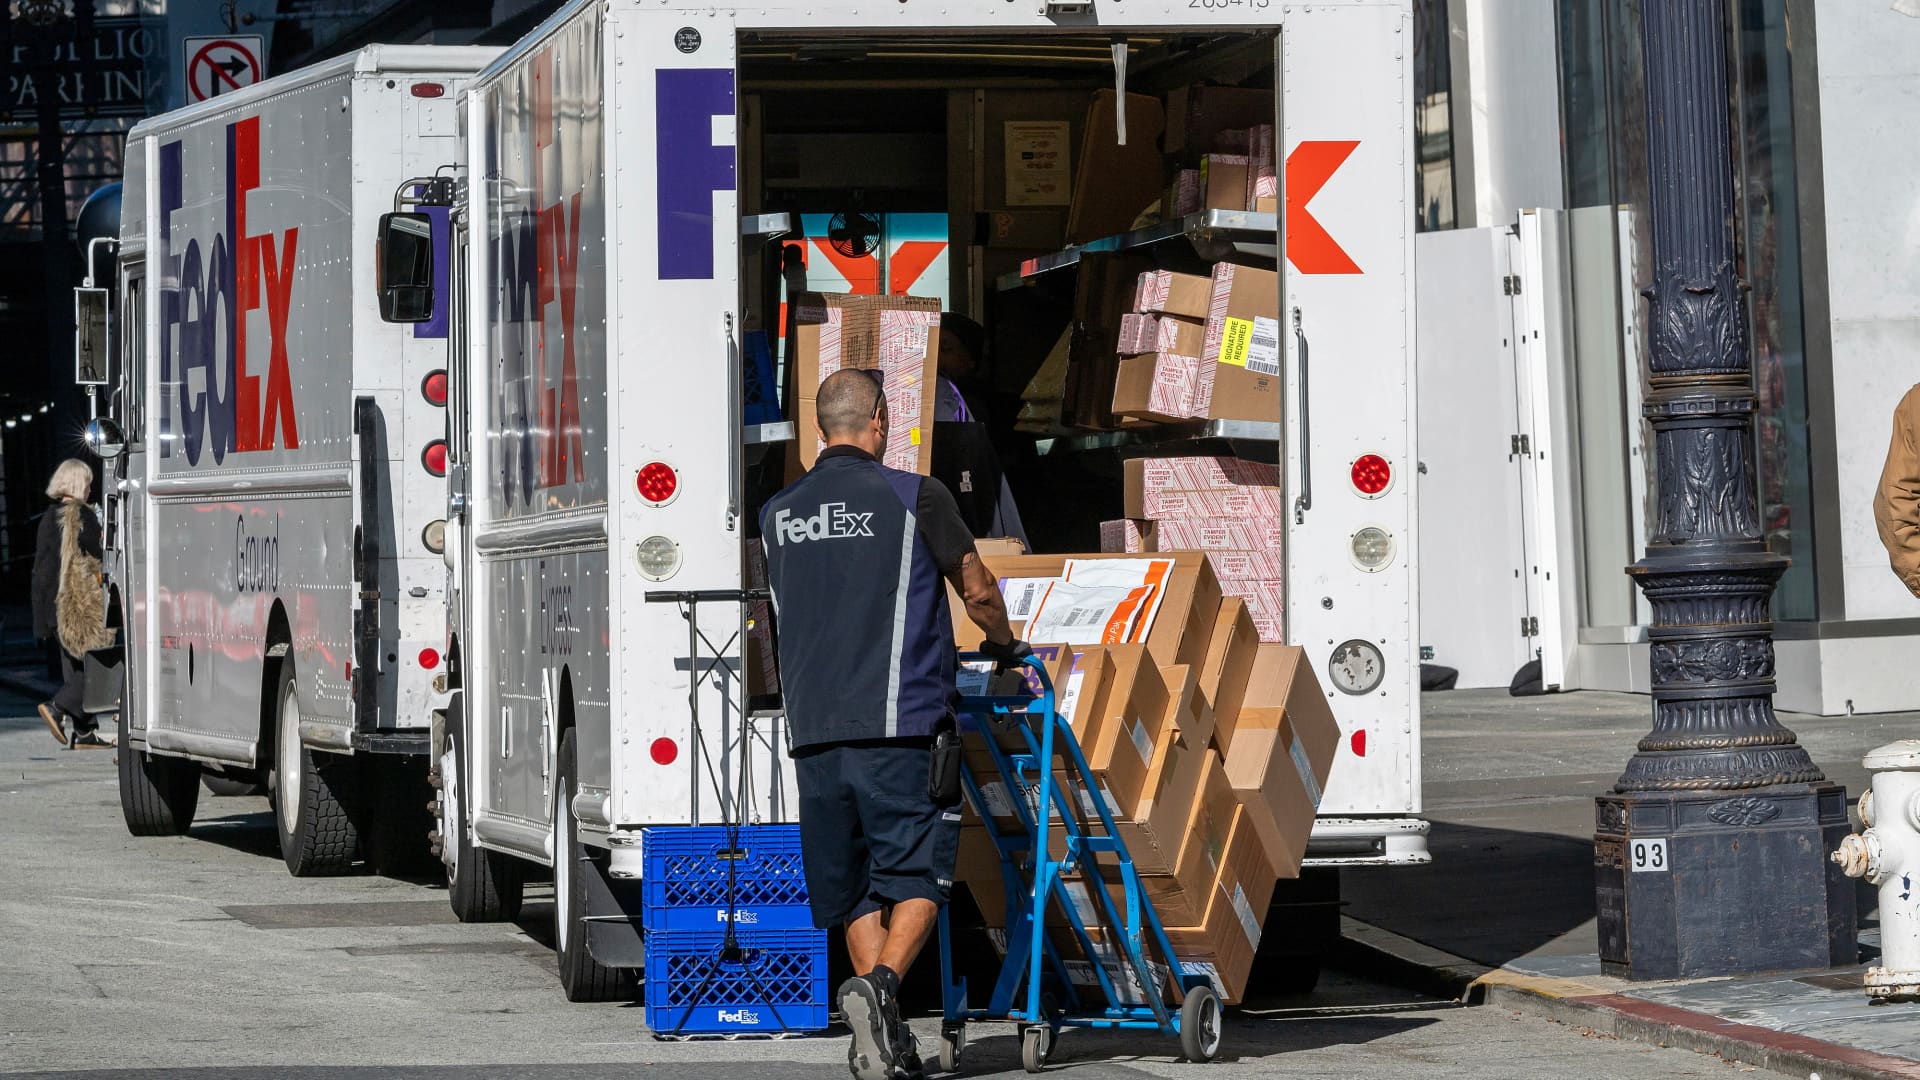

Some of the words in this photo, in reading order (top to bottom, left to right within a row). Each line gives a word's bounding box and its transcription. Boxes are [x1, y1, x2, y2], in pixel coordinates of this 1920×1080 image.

[159, 116, 299, 467] FedEx
[1224, 320, 1239, 361] SIGNATURE
[1234, 324, 1248, 361] REQUIRED
[776, 502, 874, 546] FedEx
[236, 512, 279, 592] Ground
[540, 560, 572, 667] Express
[1634, 844, 1664, 868] 93
[718, 1010, 758, 1022] FedEx
